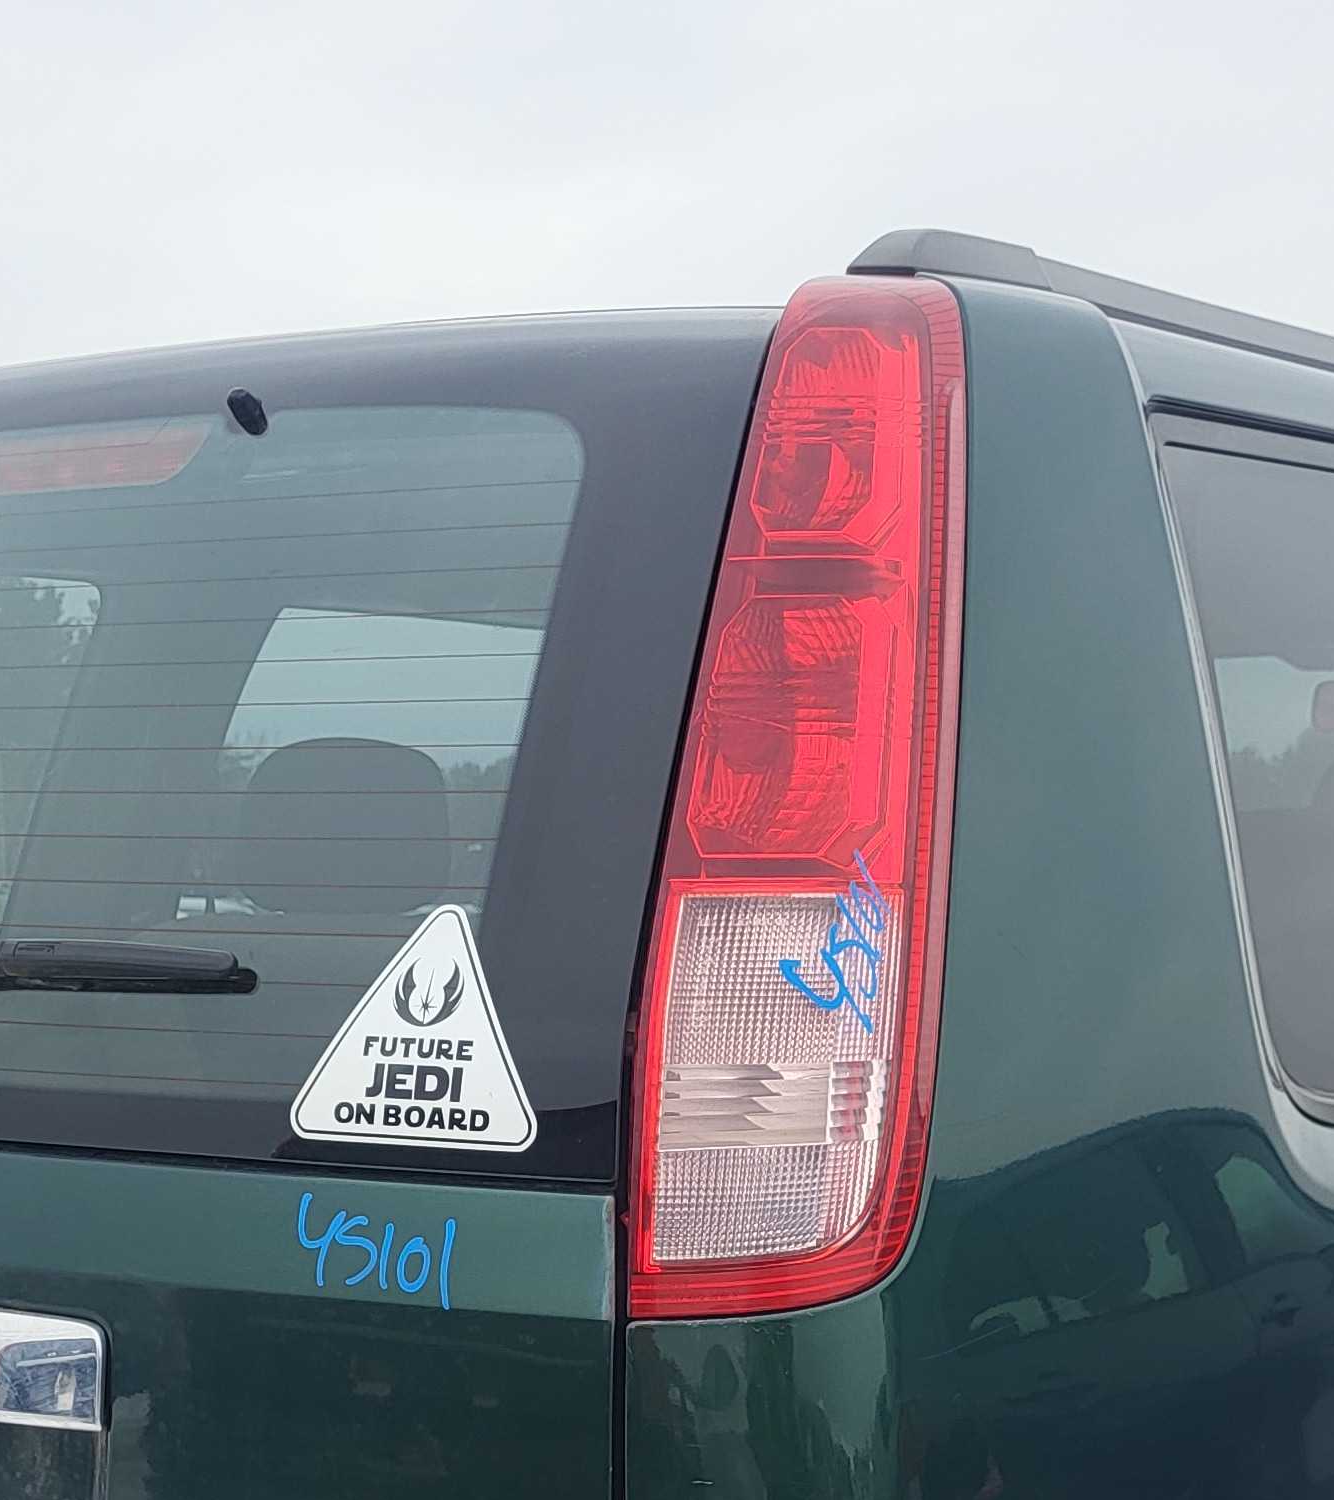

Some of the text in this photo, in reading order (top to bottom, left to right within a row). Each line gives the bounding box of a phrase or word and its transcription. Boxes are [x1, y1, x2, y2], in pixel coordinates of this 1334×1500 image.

[363, 1036, 474, 1061] FUTURE
[365, 1063, 464, 1102] JEDI
[334, 1101, 490, 1132] ON BOARD
